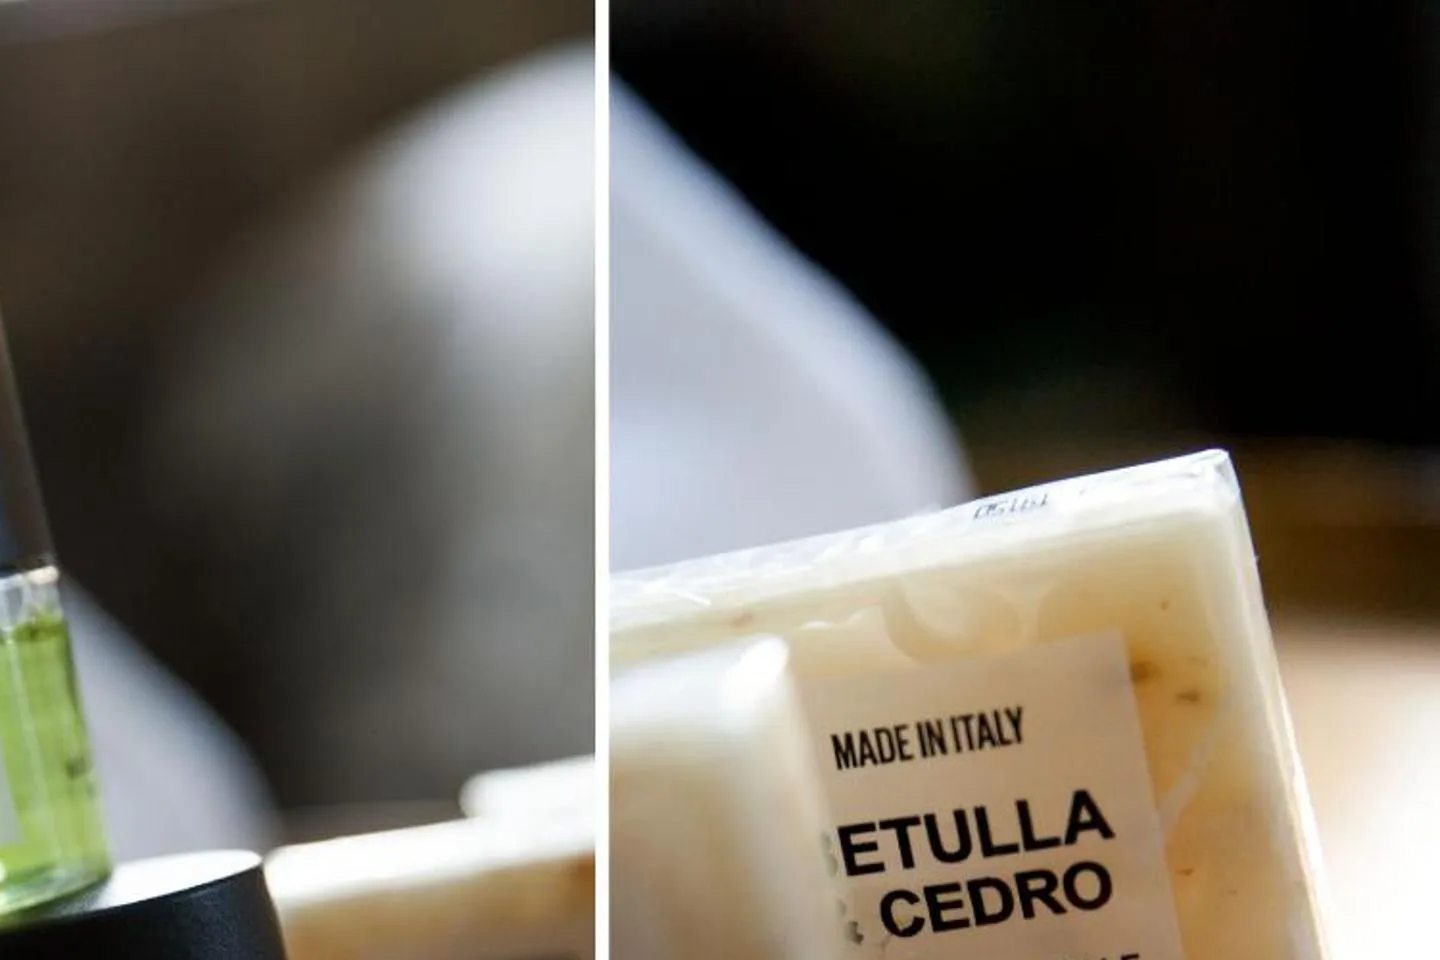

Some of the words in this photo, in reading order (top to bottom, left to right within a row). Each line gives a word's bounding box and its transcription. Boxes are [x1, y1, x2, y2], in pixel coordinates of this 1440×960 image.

[831, 724, 913, 771] MADE
[916, 718, 948, 759] IN
[952, 706, 1024, 753] ITALY
[823, 788, 1116, 876] ETULLA
[879, 861, 1113, 938] CEDRO
